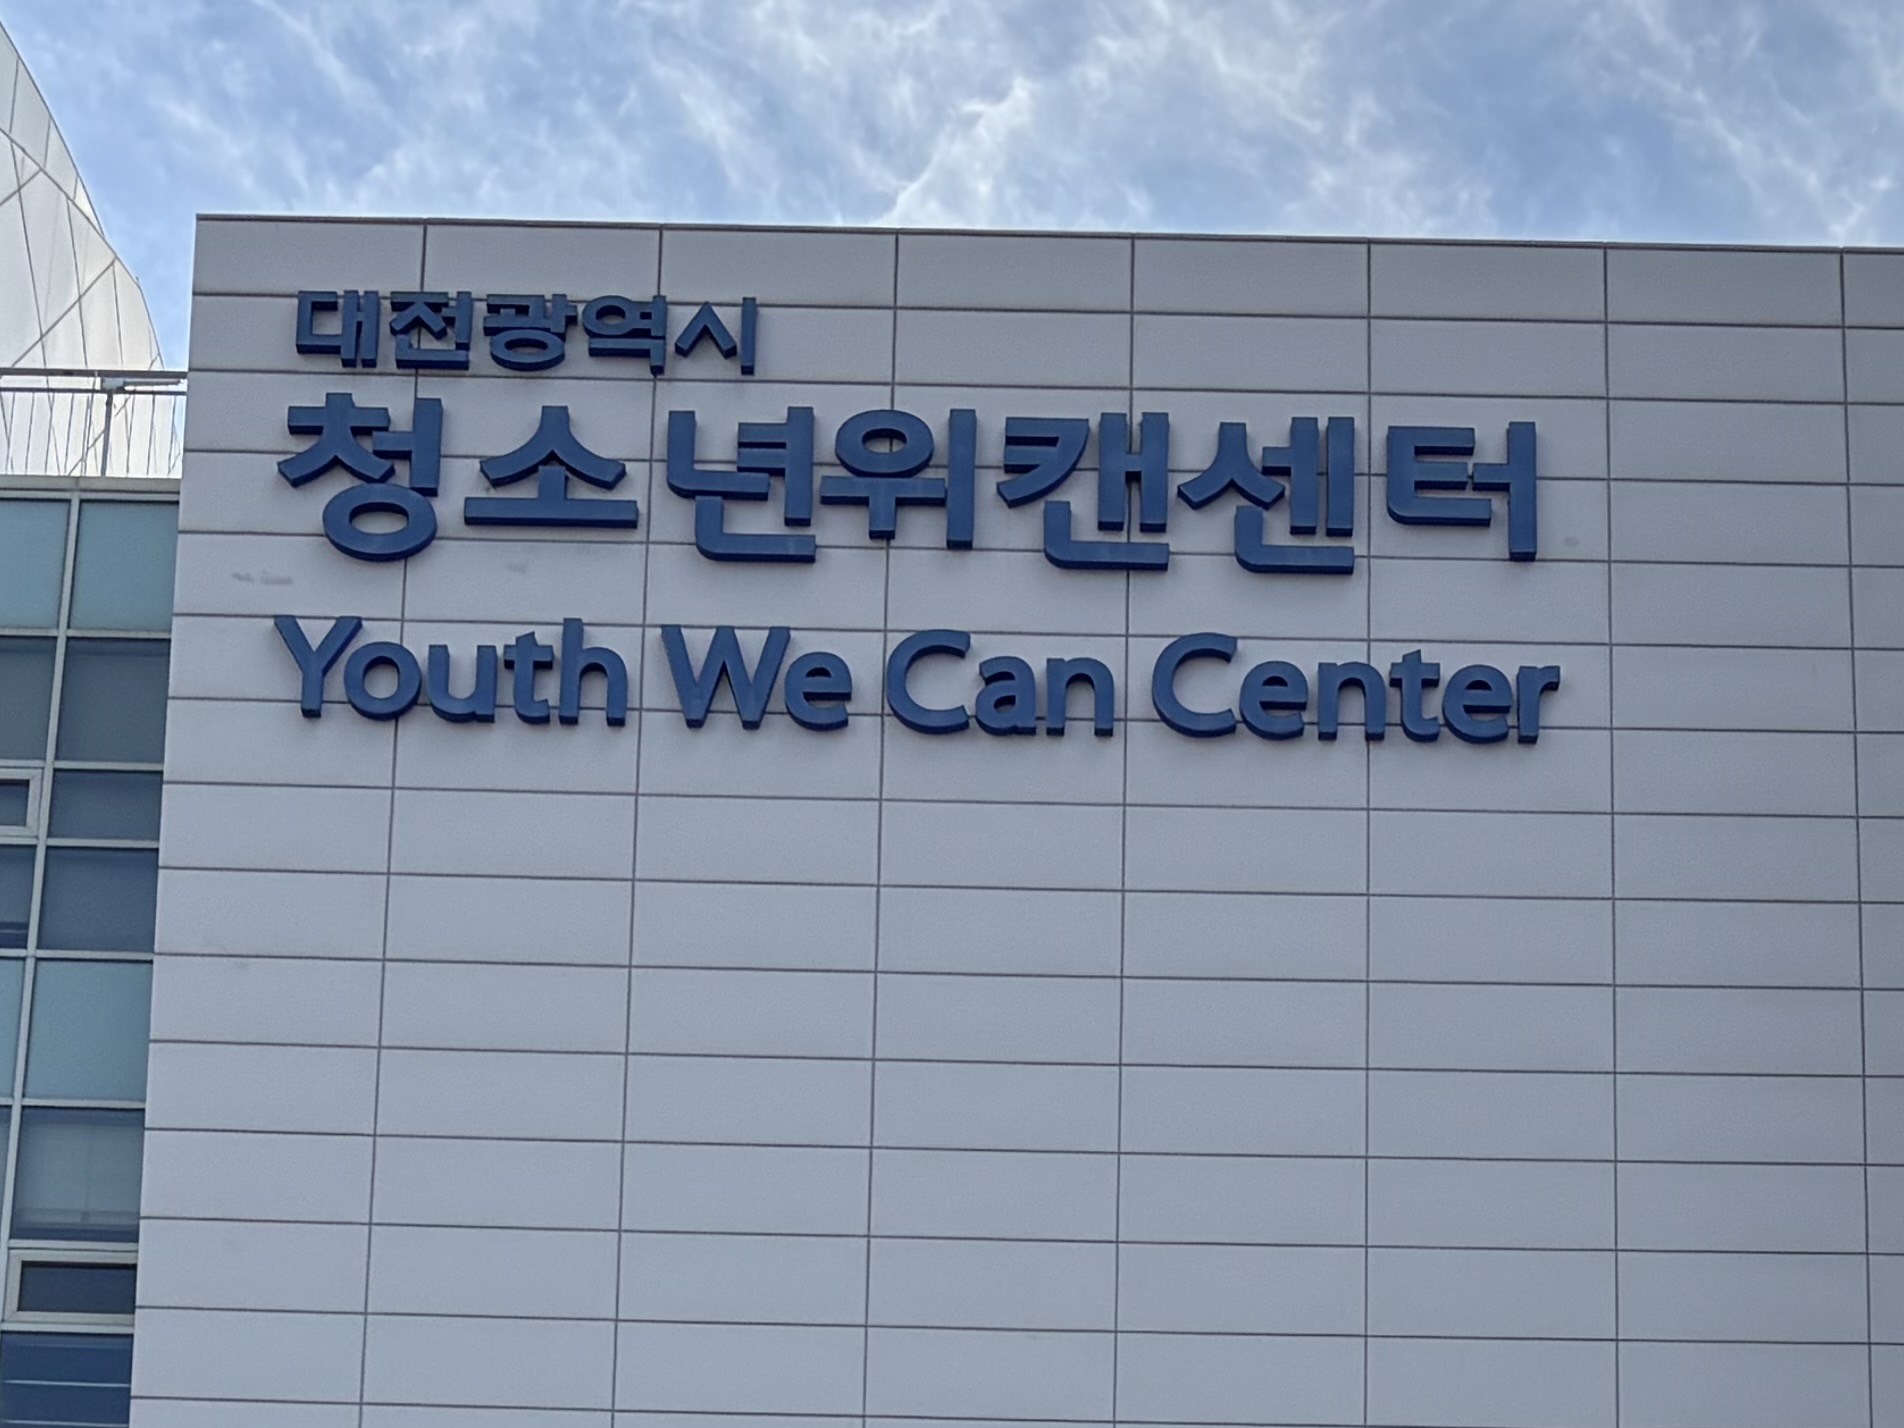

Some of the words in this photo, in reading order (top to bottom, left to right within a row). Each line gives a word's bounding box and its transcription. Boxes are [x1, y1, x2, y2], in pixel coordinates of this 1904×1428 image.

[295, 289, 760, 376] 대전광역시
[277, 390, 1540, 574] 청소년위캔센터
[274, 614, 630, 727] Youth
[661, 624, 855, 731] We
[884, 628, 1118, 735] Can
[1151, 632, 1562, 744] Center
